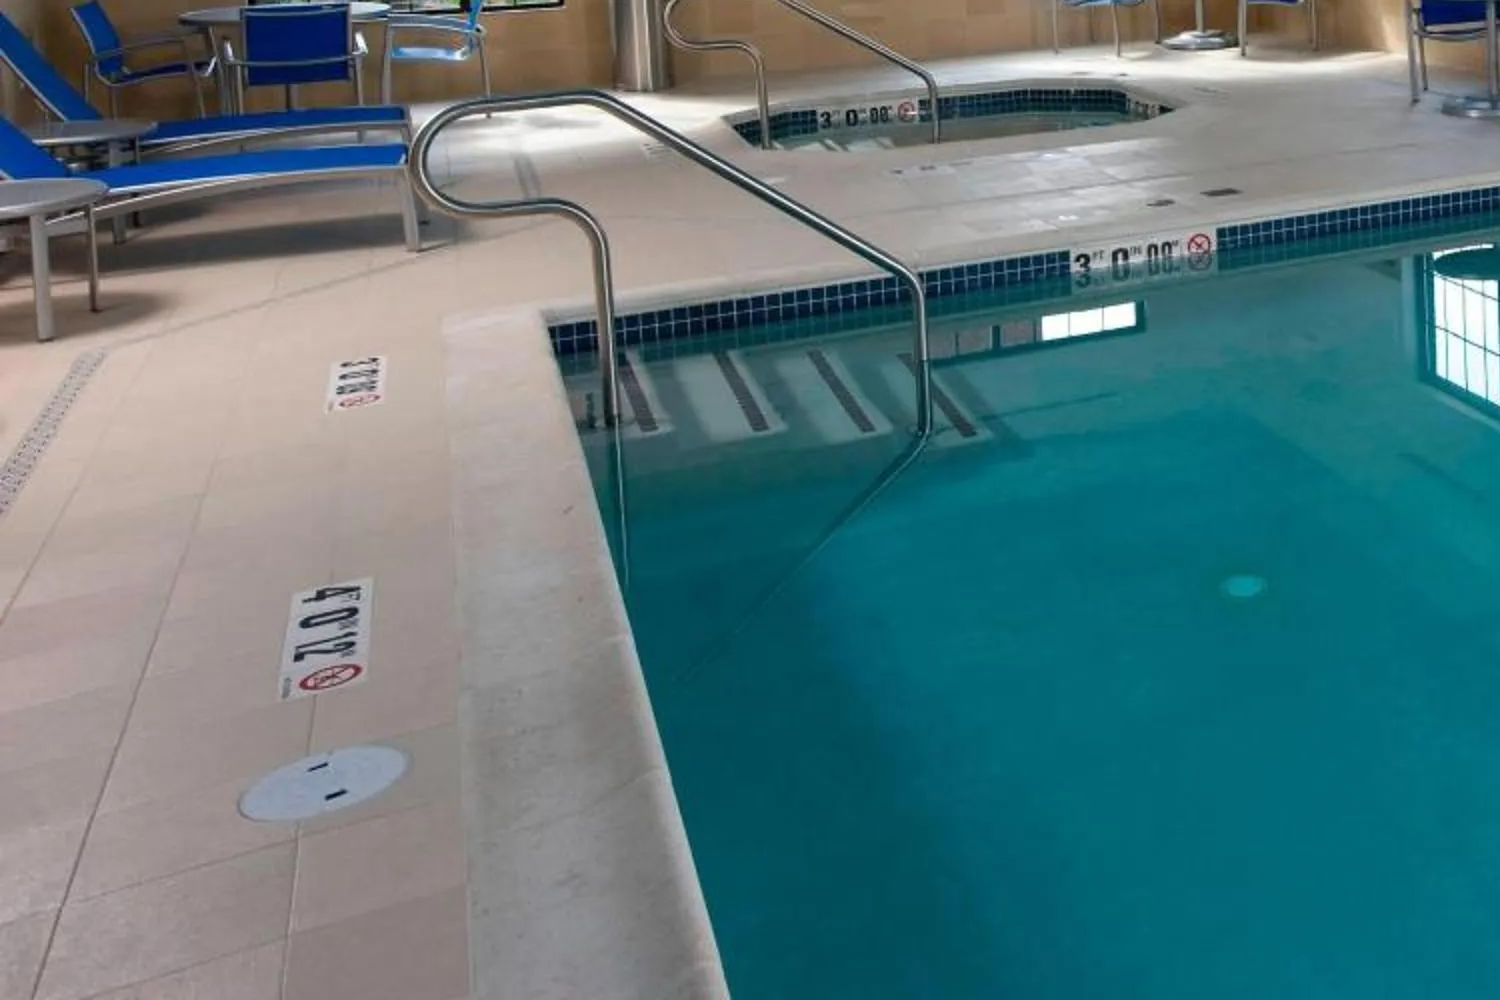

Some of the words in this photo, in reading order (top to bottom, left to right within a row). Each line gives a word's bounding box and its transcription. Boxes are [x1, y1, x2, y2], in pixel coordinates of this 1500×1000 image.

[1075, 253, 1091, 275] 3
[302, 586, 361, 604] 4
[299, 607, 359, 629] 0
